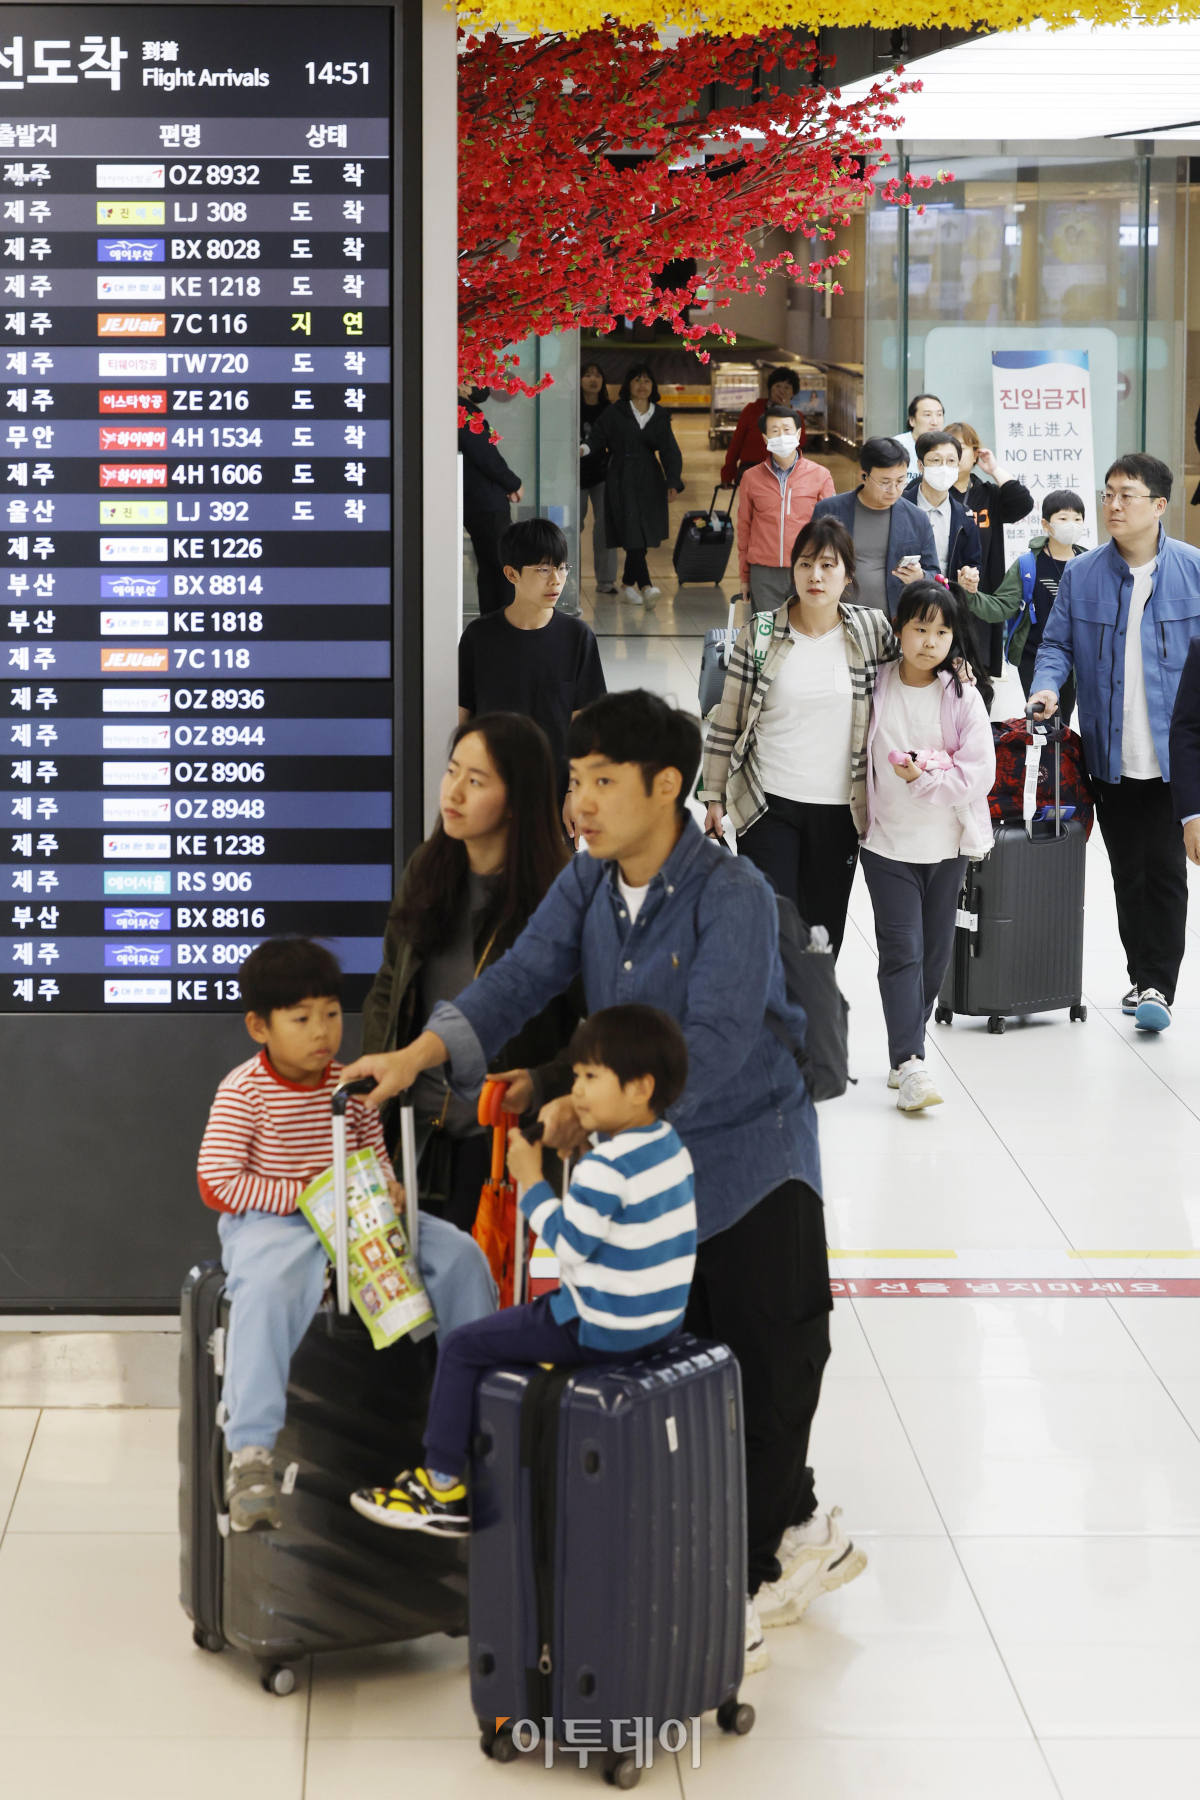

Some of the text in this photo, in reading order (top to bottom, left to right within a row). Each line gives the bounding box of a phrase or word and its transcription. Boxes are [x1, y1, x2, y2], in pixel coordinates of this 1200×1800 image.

[142, 41, 179, 61] 到着
[143, 68, 269, 91] Flight Arrivals
[306, 62, 368, 84] 14:51
[160, 124, 200, 147] 편명
[306, 125, 346, 147] 상태
[169, 165, 202, 184] OZ
[207, 165, 259, 184] 8932
[174, 202, 197, 222] LJ
[207, 202, 247, 222] 308
[109, 250, 153, 261] 에어부산
[172, 240, 201, 259] BX
[207, 240, 260, 259] 8028
[172, 277, 201, 296] KE
[209, 277, 260, 296] 1218
[101, 318, 163, 332] JEJUair
[171, 314, 202, 333] 7C
[209, 314, 247, 333] 116
[103, 395, 163, 408] 이스타항공
[173, 391, 203, 410] ZE
[209, 391, 248, 410] 216
[1000, 388, 1086, 410] 진입금지
[117, 431, 165, 447] 하이에어
[171, 428, 203, 447] 4H
[210, 428, 263, 447] 1534
[1008, 422, 1079, 437] 禁止进入
[1006, 448, 1082, 462] NO ENTRY
[117, 469, 165, 484] 하이에어
[172, 465, 203, 484] 4H
[211, 465, 262, 484] 1606
[177, 502, 200, 521] LJ
[210, 501, 249, 521] 392
[174, 539, 204, 558] KE
[211, 539, 262, 558] 1226
[113, 586, 157, 597] 에어부산
[174, 575, 204, 595] BX
[209, 575, 263, 595] 8814
[175, 612, 204, 631] KE
[211, 612, 262, 631] 1818
[104, 653, 166, 667] JEJUair
[174, 649, 205, 668] 7C
[212, 649, 250, 668] 118
[175, 689, 207, 709] OZ
[212, 690, 264, 709] 8936
[175, 726, 207, 745] OZ
[212, 726, 265, 745] 8944
[175, 763, 207, 782] OZ
[212, 763, 264, 782] 8906
[175, 799, 208, 818] OZ
[212, 799, 265, 818] 8948
[177, 836, 206, 855] KE
[214, 836, 264, 855] 1238
[108, 875, 166, 891] 에어서울
[178, 872, 206, 891] RS
[212, 872, 252, 891] 906
[116, 918, 160, 930] 에어부산
[178, 908, 207, 927] BX
[212, 908, 265, 927] 8816
[116, 955, 160, 966] 에어부산
[178, 944, 207, 964] BX
[212, 944, 258, 964] 809
[178, 981, 207, 1000] KE
[215, 981, 241, 1000] 13
